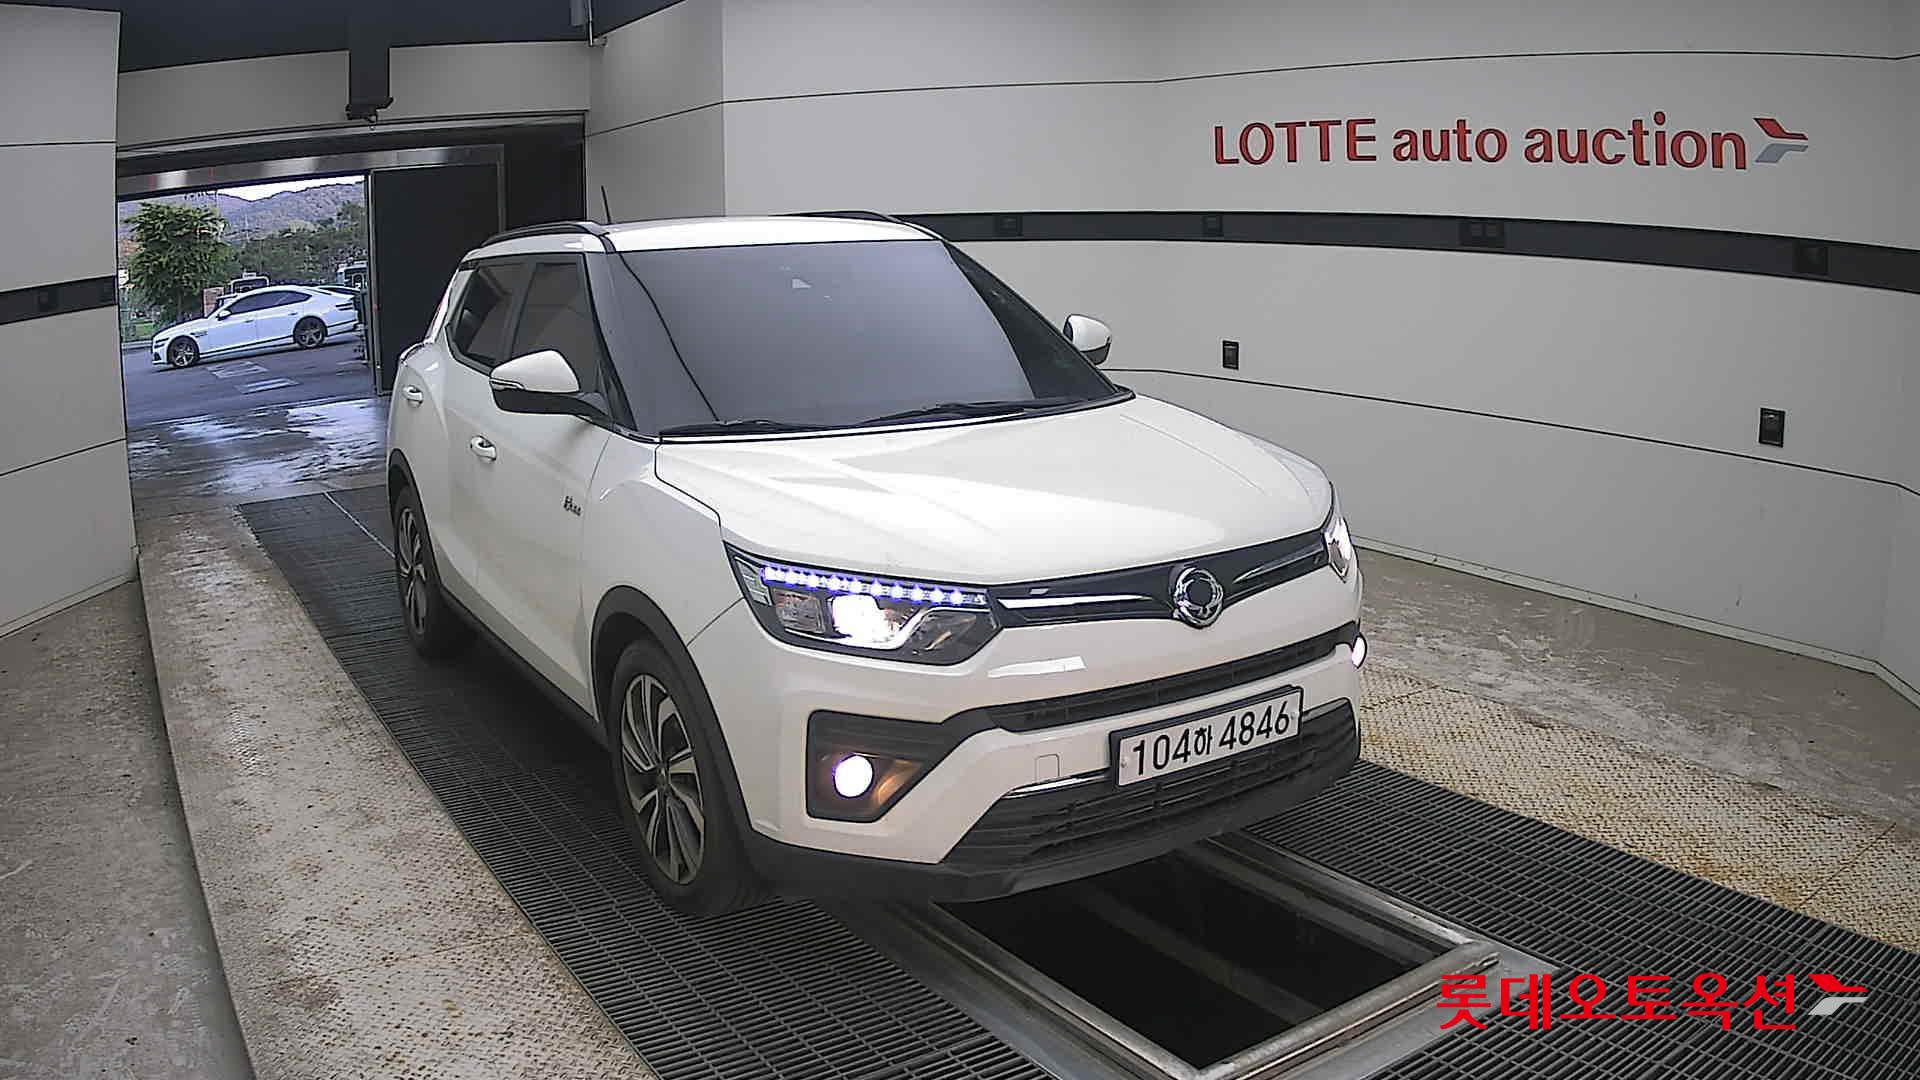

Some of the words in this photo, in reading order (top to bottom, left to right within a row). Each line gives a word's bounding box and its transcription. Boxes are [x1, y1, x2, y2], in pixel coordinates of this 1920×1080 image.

[1214, 118, 1377, 165] LOTTE
[1392, 119, 1508, 163] auto
[1524, 111, 1747, 170] auction
[1133, 725, 1213, 775] 104하
[1219, 700, 1290, 750] 4846
